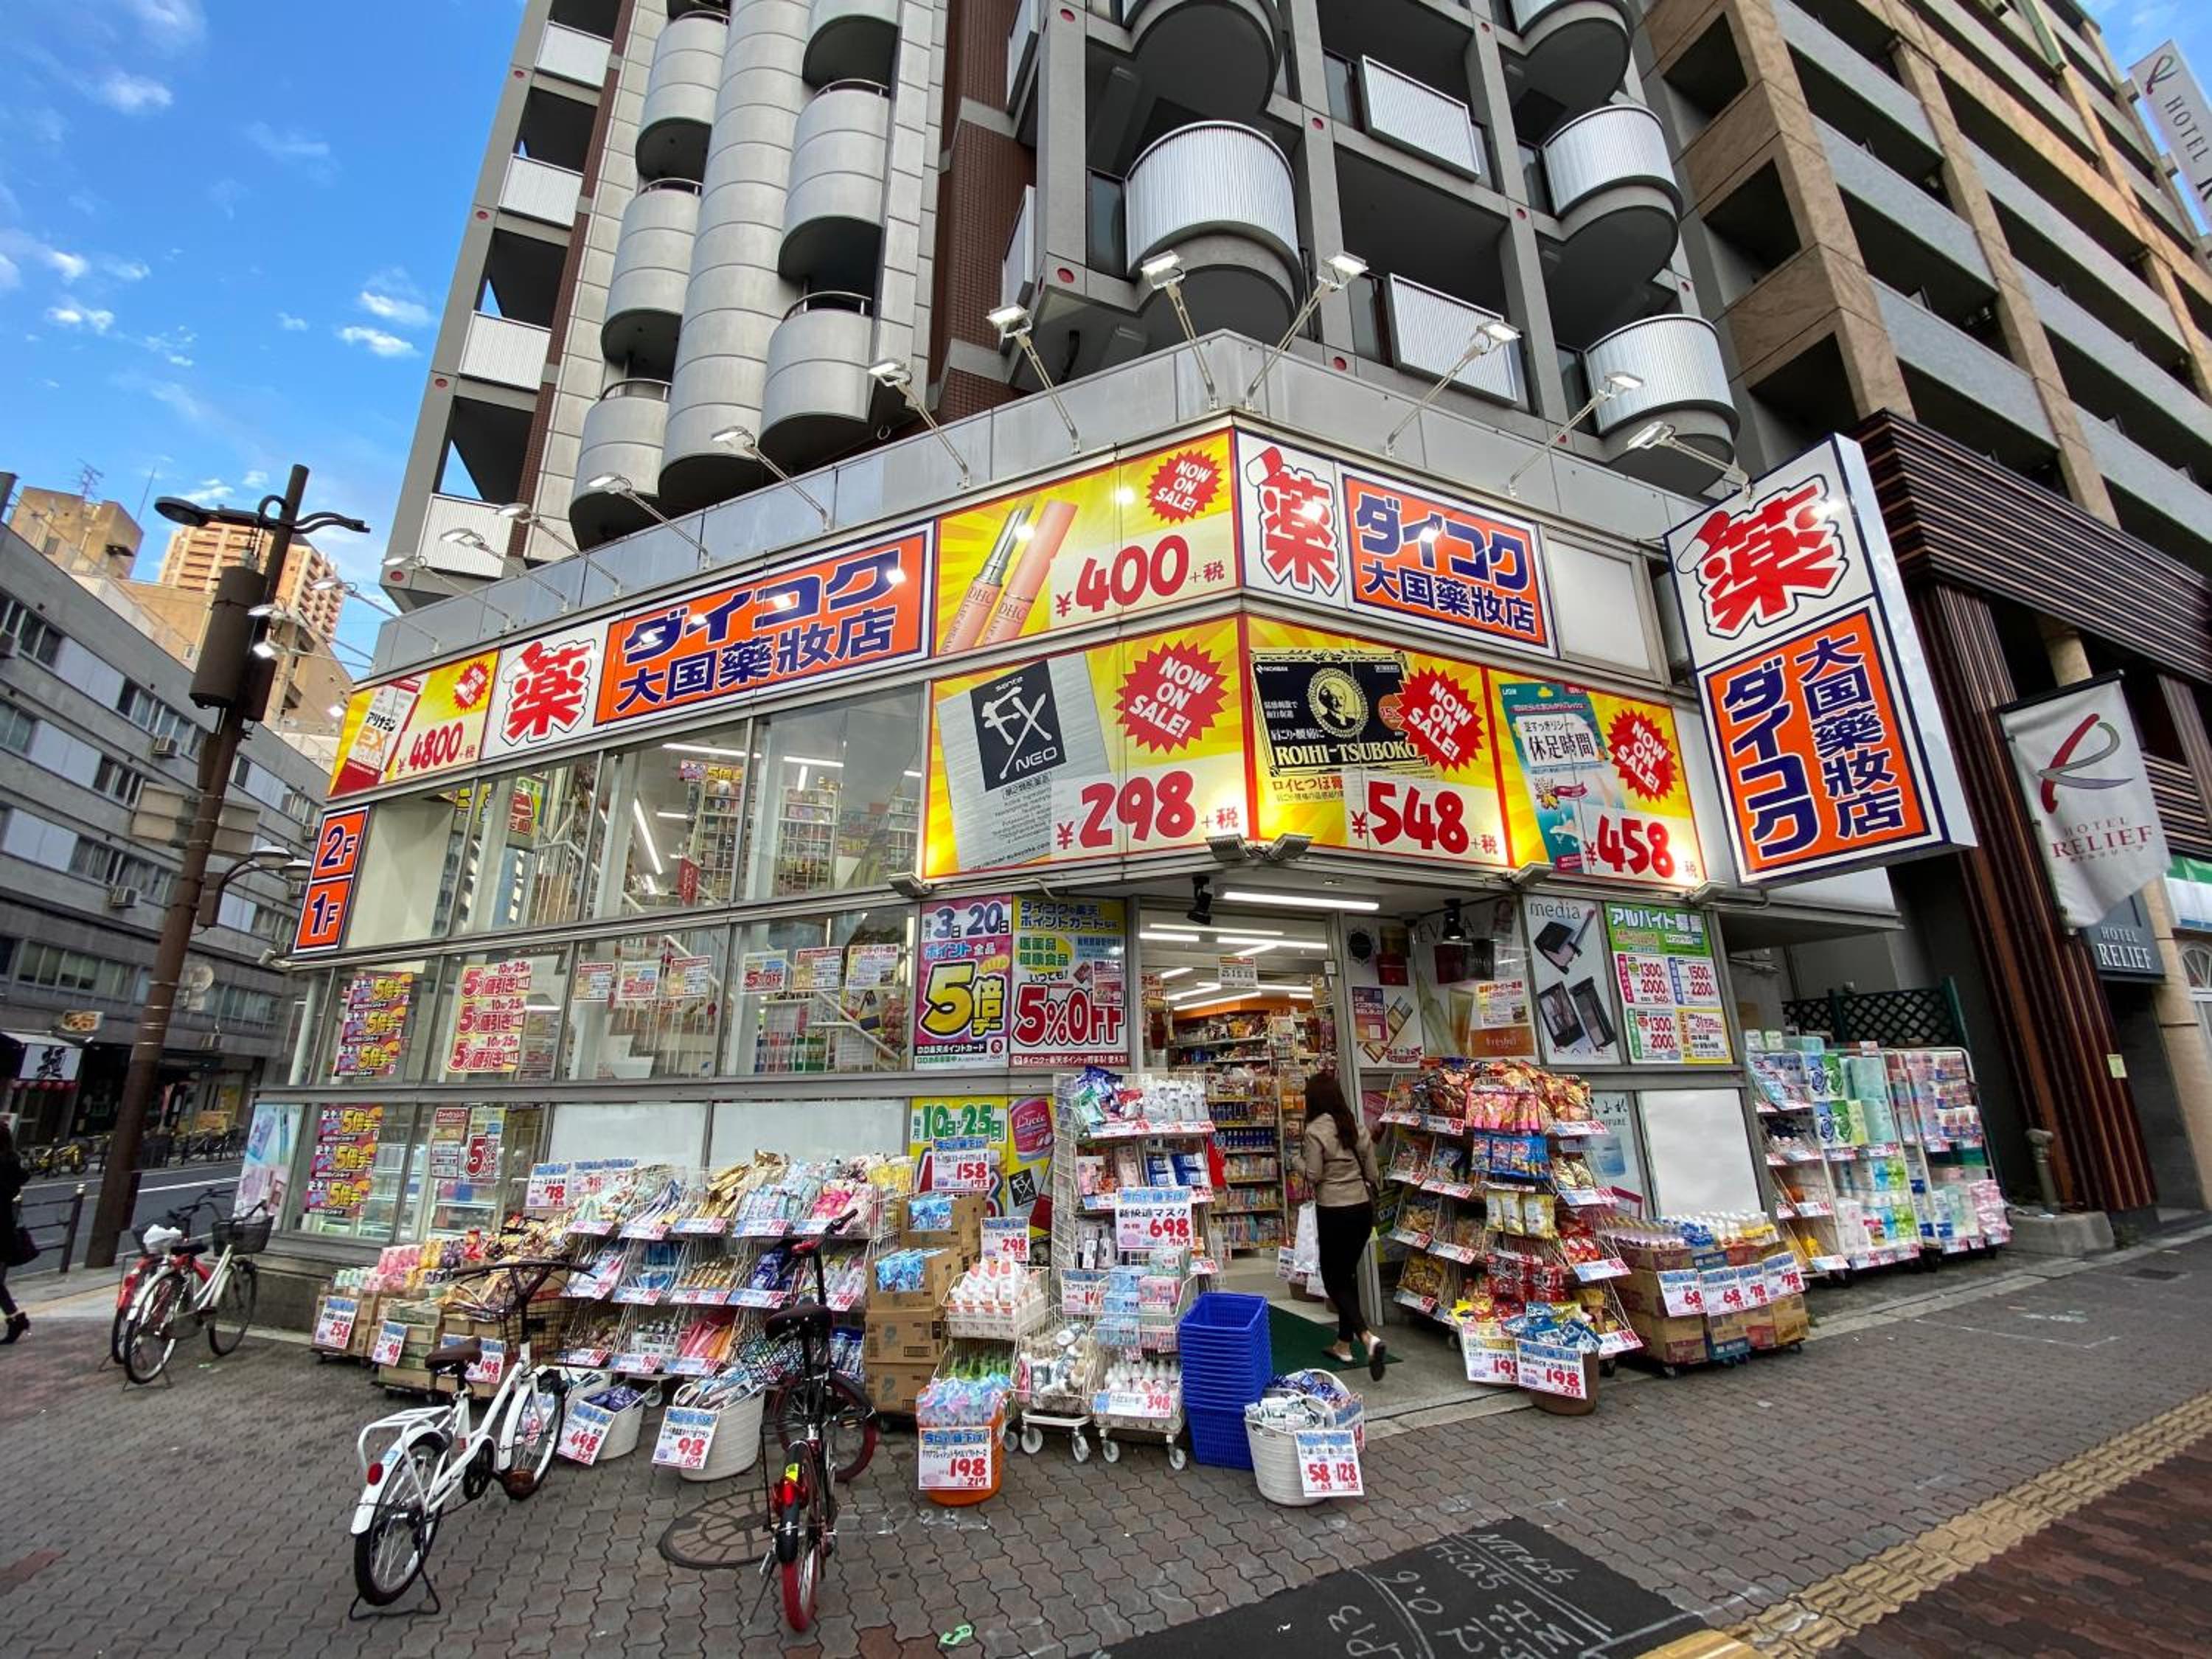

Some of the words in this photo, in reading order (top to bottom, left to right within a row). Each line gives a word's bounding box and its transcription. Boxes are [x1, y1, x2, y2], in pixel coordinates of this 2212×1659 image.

[2165, 94, 2209, 163] HOTEL
[1175, 459, 1211, 482] NOW
[1174, 477, 1196, 494] ON
[1155, 488, 1197, 513] SALE!
[1248, 447, 1342, 589] 薬
[1355, 492, 1531, 591] ダイコク
[1677, 484, 1842, 632] 薬
[623, 548, 901, 665] ダイコク
[969, 586, 993, 605] DHC
[999, 602, 1026, 621] DHC
[1159, 656, 1213, 694] NOW
[504, 642, 592, 740] 薬
[1156, 682, 1190, 711] ON
[1429, 681, 1472, 725] NOW
[366, 712, 397, 731] アリナミン
[1130, 695, 1192, 738] SALE!
[1429, 705, 1458, 736] ON
[981, 686, 1051, 779] FX
[1408, 706, 1462, 762] SALE!
[1632, 720, 1667, 761] NOW
[1528, 732, 1595, 761] 休足時間
[1632, 743, 1655, 770] ON
[1015, 746, 1057, 772] NEO
[1617, 745, 1660, 793] SALE!
[1723, 656, 1821, 860] ダイコク
[2064, 816, 2129, 838] HOTEL
[319, 825, 357, 870] 2F
[2051, 825, 2153, 859] RELIEF
[310, 891, 340, 938] 1F
[1530, 902, 1580, 919] media
[2101, 924, 2138, 942] HOTEL
[925, 942, 971, 958] ポイント
[974, 942, 996, 956] 全品
[2096, 943, 2152, 970] RELIEF
[1015, 985, 1124, 1046] 5%OFF
[956, 1163, 987, 1180] 158
[545, 1186, 565, 1199] 78
[1149, 1217, 1190, 1239] 698
[1003, 1238, 1027, 1253] 298
[1781, 1272, 1800, 1287] 78
[1684, 1291, 1703, 1306] 68
[1723, 1290, 1742, 1304] 68
[1750, 1284, 1766, 1299] 78
[330, 1321, 349, 1338] 258
[387, 1344, 400, 1358] 98
[480, 1359, 500, 1374] 198
[1546, 1368, 1580, 1387] 198
[1146, 1394, 1170, 1411] 398
[570, 1432, 599, 1453] 498
[678, 1437, 706, 1456] 98
[950, 1458, 987, 1477] 198
[1308, 1464, 1330, 1483] 58
[1336, 1463, 1357, 1483] 128
